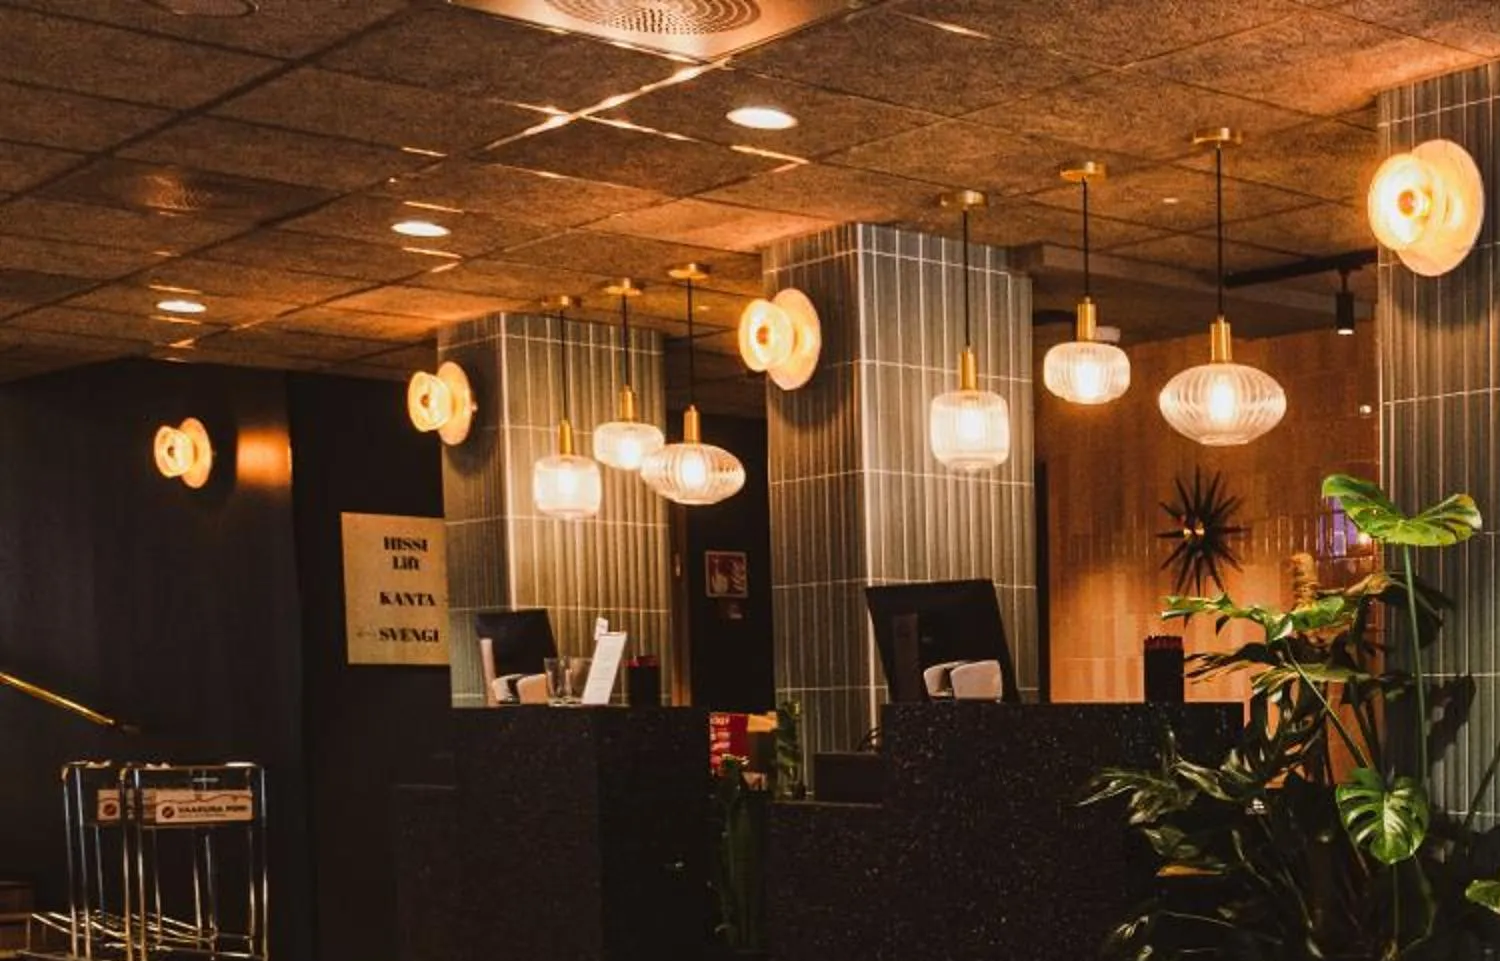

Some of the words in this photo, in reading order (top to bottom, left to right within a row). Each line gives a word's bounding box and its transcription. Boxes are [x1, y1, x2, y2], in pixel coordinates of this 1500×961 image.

[383, 536, 428, 552] HISSI
[392, 555, 420, 570] Lift
[379, 591, 436, 606] KANTA
[378, 627, 440, 642] SVENGI
